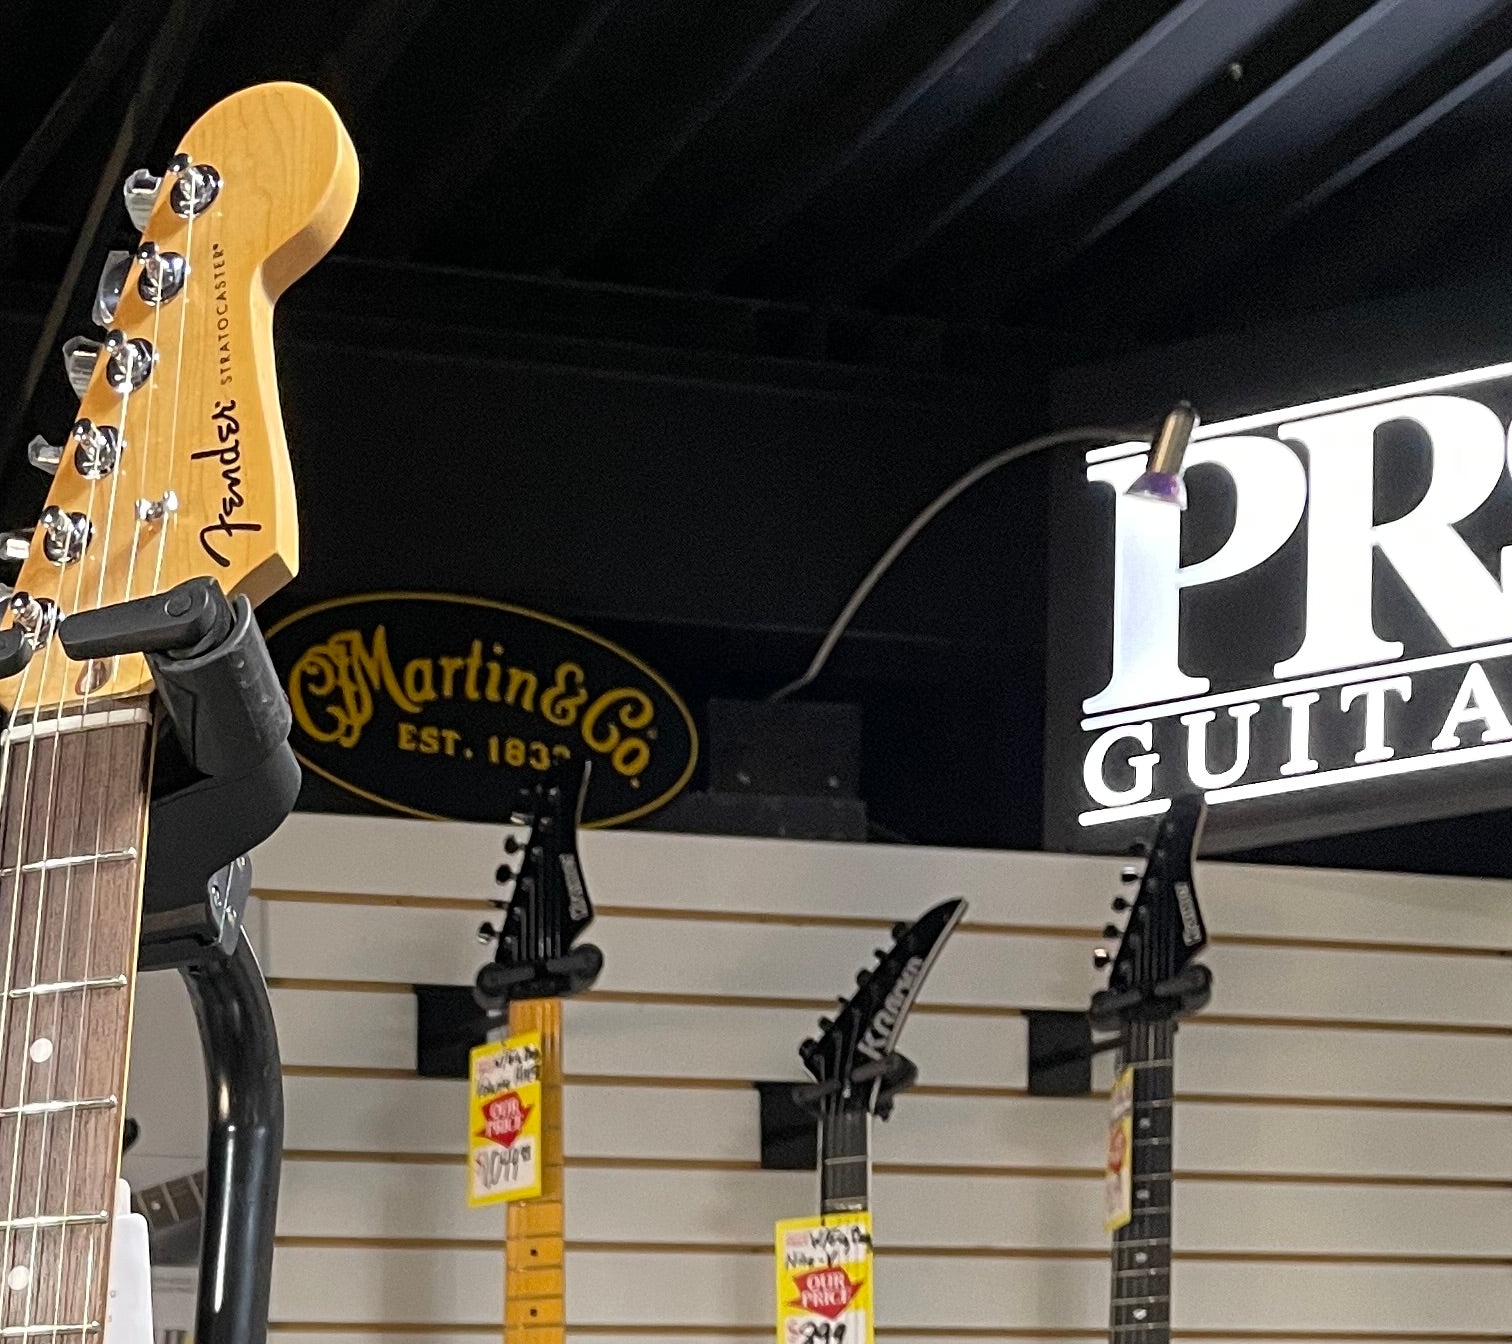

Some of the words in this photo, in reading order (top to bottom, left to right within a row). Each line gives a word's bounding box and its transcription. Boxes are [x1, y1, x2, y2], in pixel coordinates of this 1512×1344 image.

[191, 399, 261, 567] Fender
[1083, 395, 1512, 714] PR
[398, 722, 474, 760] EST.
[806, 1271, 846, 1291] OUR
